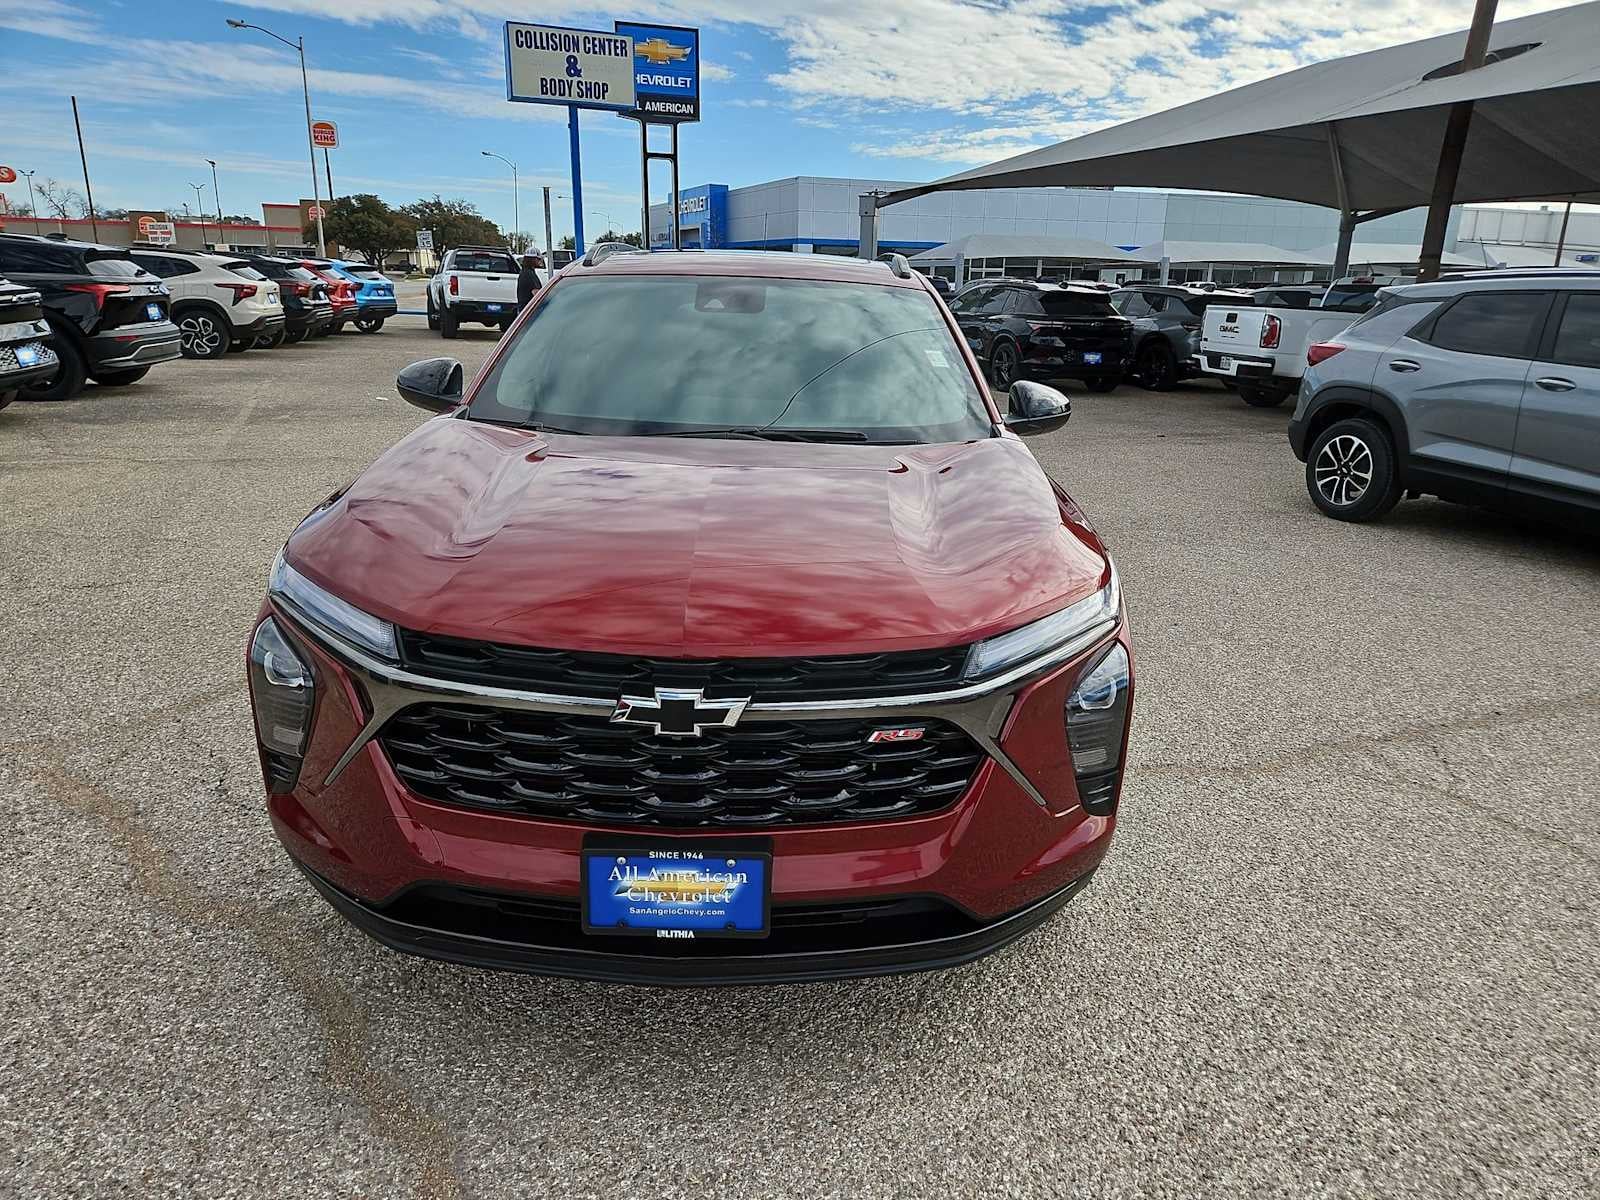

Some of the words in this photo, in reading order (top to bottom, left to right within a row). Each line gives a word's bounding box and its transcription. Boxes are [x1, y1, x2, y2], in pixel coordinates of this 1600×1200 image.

[515, 29, 579, 54] COLLISION
[583, 35, 628, 57] CENTER
[565, 54, 582, 78] &
[636, 73, 692, 88] HEVROLET
[540, 77, 573, 98] BODY
[576, 80, 609, 100] SHOP
[645, 101, 694, 114] AMERICAN
[314, 134, 336, 142] KING
[1219, 325, 1240, 334] GMC
[867, 727, 926, 743] RS
[649, 851, 680, 859] SINCE
[682, 852, 704, 860] 1946
[607, 865, 638, 881] All
[647, 867, 749, 884] American
[626, 886, 732, 903] Chevrolet
[628, 907, 725, 916] SanAngeloChevy.com
[665, 930, 695, 939] LITHIA
